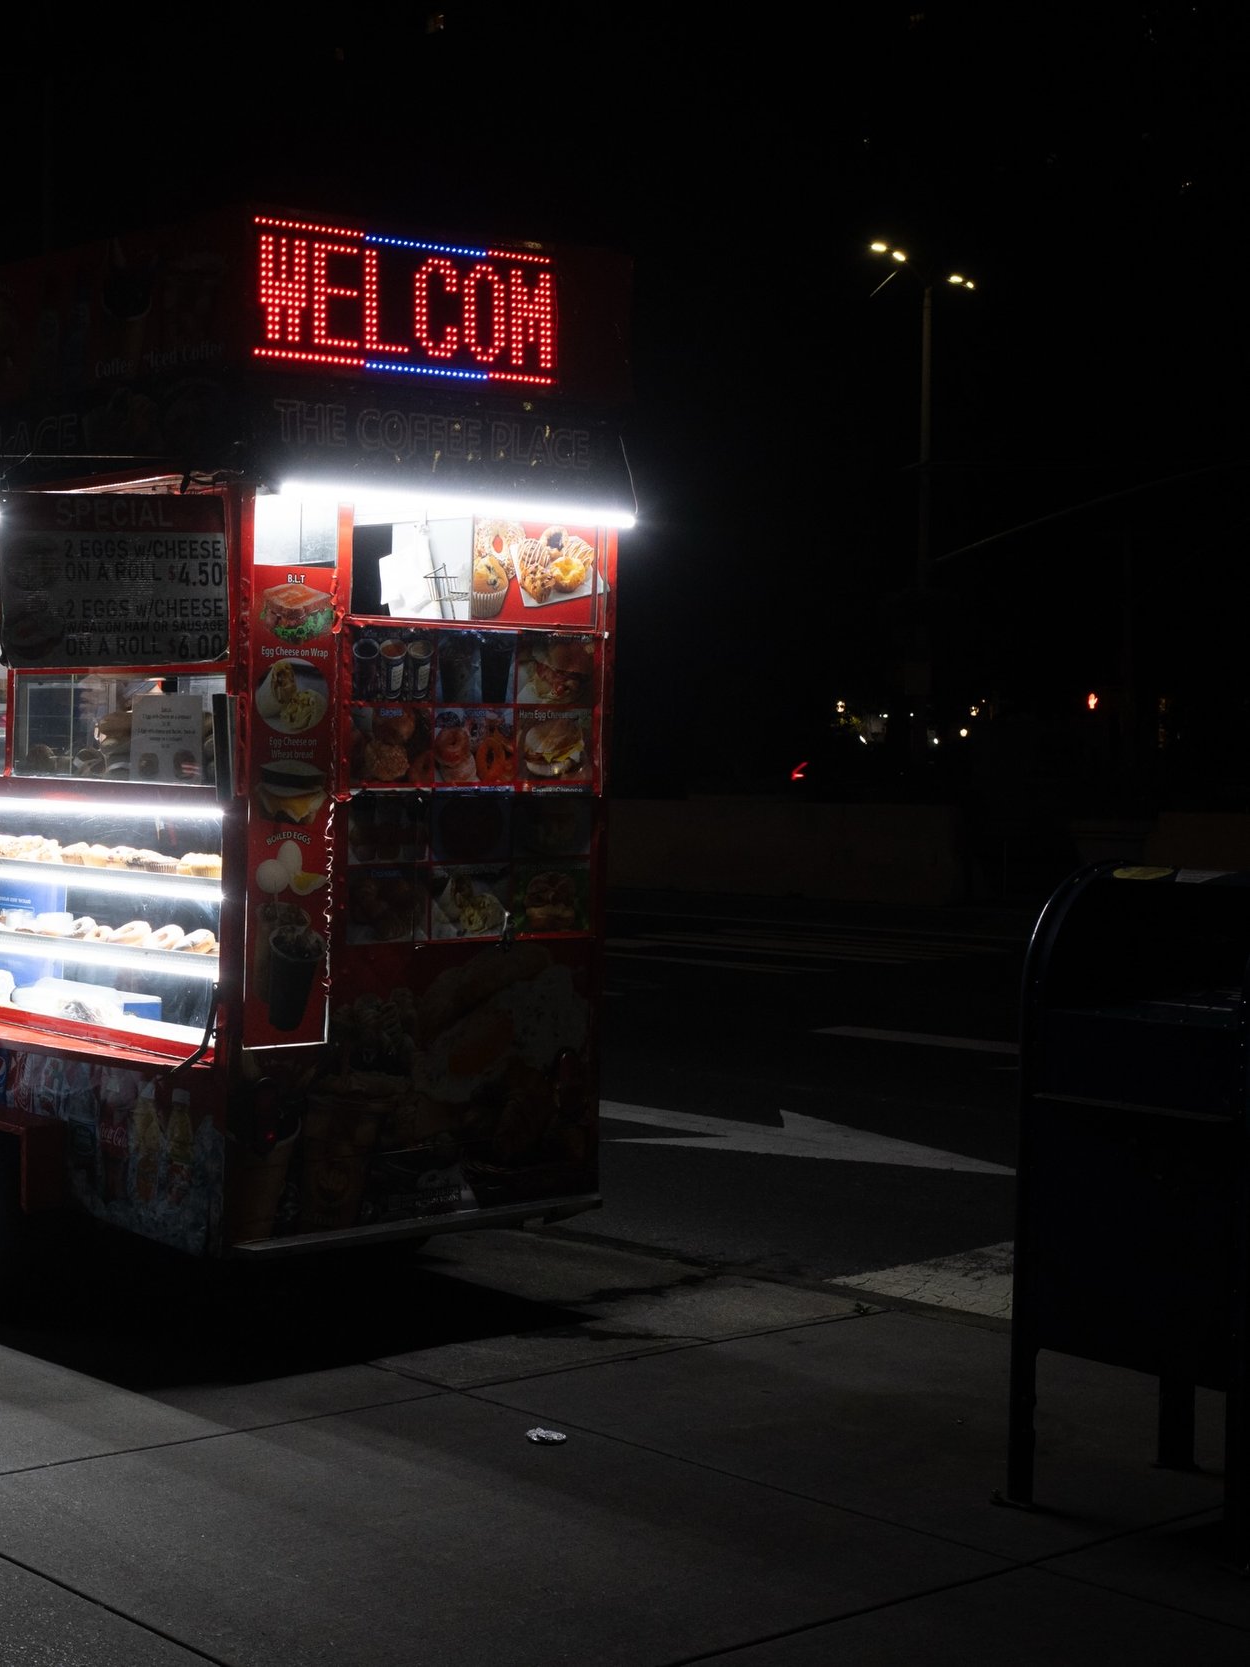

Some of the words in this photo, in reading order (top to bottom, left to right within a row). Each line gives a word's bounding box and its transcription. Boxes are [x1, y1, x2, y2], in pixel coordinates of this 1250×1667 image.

[260, 233, 552, 368] WELCOM
[273, 398, 348, 448] THE
[356, 407, 482, 460] COFFEE
[490, 420, 591, 471] PLACE
[56, 499, 174, 528] SPECIAL
[65, 540, 74, 559] 2
[81, 540, 129, 559] EGGS
[65, 564, 90, 582] ON
[98, 564, 114, 582] A
[115, 564, 162, 582] ROLL
[167, 562, 223, 587] $4.50
[66, 601, 75, 619] 2
[82, 600, 129, 619] EGGS
[172, 620, 224, 632] SAUSAGE
[66, 638, 91, 656] ON
[98, 637, 114, 656] A
[116, 636, 162, 656] ROLL
[261, 645, 275, 657] Egg
[276, 645, 300, 657] Cheese
[300, 648, 310, 657] on
[310, 647, 329, 658] Wrap
[266, 832, 293, 846] BOILED
[293, 832, 312, 845] EGGS
